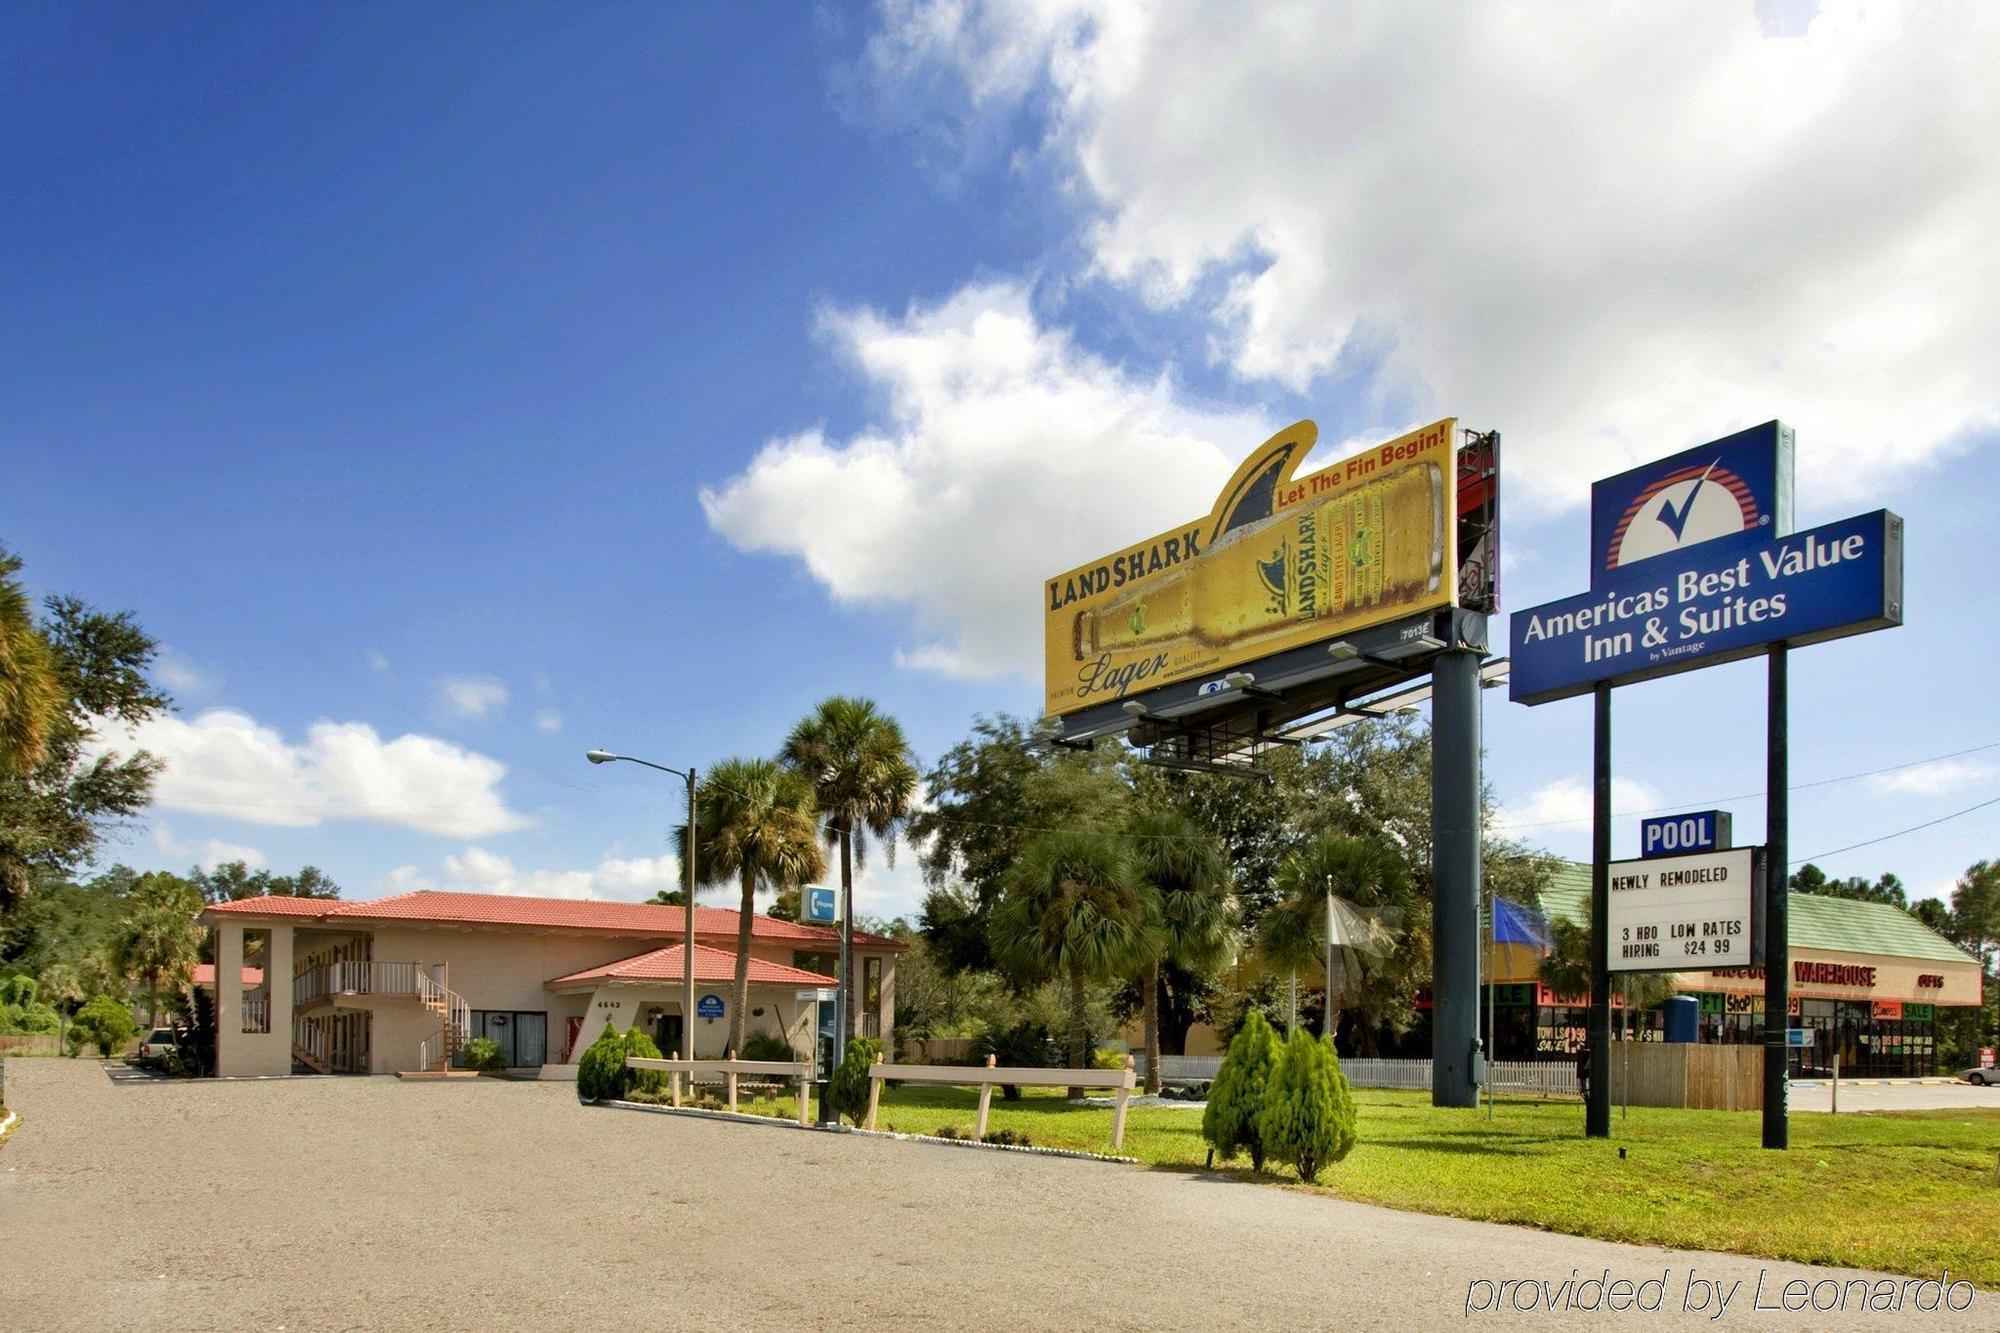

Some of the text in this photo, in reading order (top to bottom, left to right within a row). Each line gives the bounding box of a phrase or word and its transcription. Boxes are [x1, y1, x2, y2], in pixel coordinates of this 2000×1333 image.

[1278, 424, 1446, 507] Let The Fin Begin!
[1051, 528, 1201, 611] LANDSHARK
[1524, 533, 1864, 645] Americas Best Value
[1402, 622, 1430, 640] 7013E
[1584, 593, 1786, 664] Inn & Suites
[1649, 641, 1705, 662] by Vantage
[1077, 652, 1169, 698] Lager
[1647, 818, 1712, 851] POOL
[1612, 867, 1728, 891] NEWLY REMODELED
[1622, 920, 1742, 941] 3 HBO LOW RATES
[1622, 939, 1730, 958] HIRING $24 99
[1794, 961, 1877, 987] WAREHOUSE
[1904, 1003, 1928, 1018] SALE
